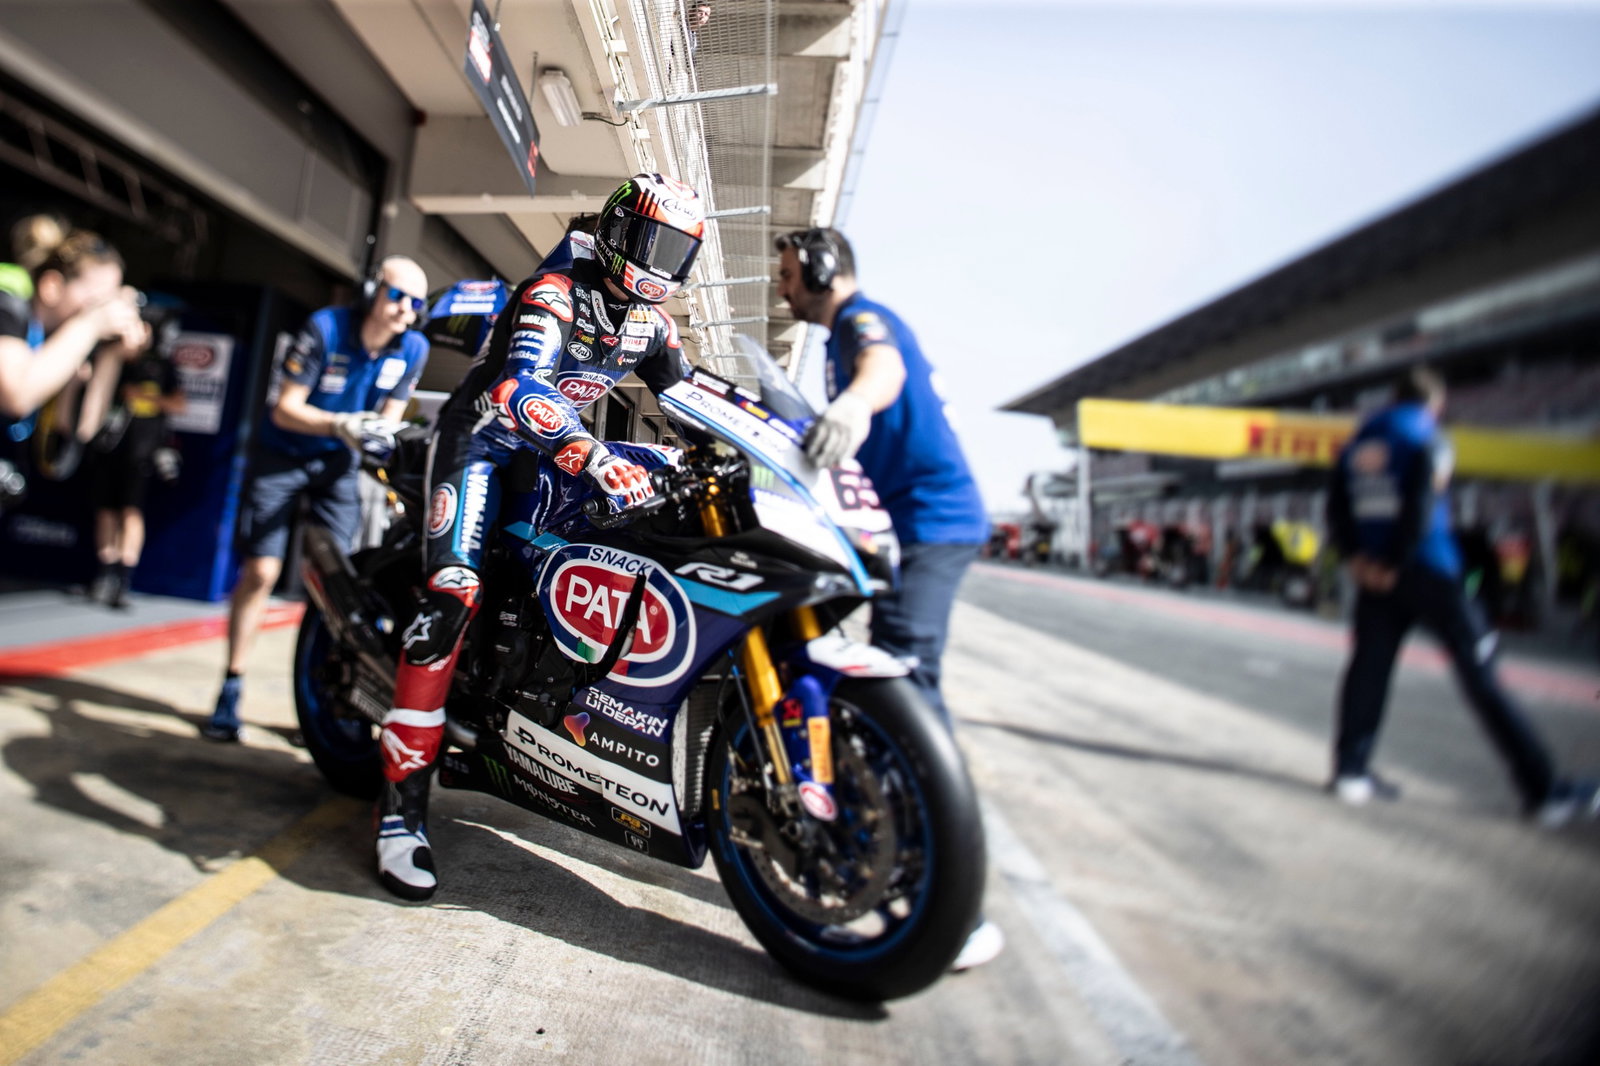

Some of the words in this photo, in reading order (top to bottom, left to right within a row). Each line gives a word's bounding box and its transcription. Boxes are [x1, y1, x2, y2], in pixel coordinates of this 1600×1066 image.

[563, 381, 600, 399] PATA
[582, 373, 607, 383] SNACK
[528, 402, 560, 428] PATA
[590, 547, 652, 578] SNACK
[565, 574, 651, 645] PATA
[589, 686, 668, 729] SEMAKIN
[589, 731, 660, 767] AMPITO
[503, 742, 579, 796] YAMALUBE
[513, 726, 670, 816] PROMETEON
[513, 774, 596, 828] MONSTER
